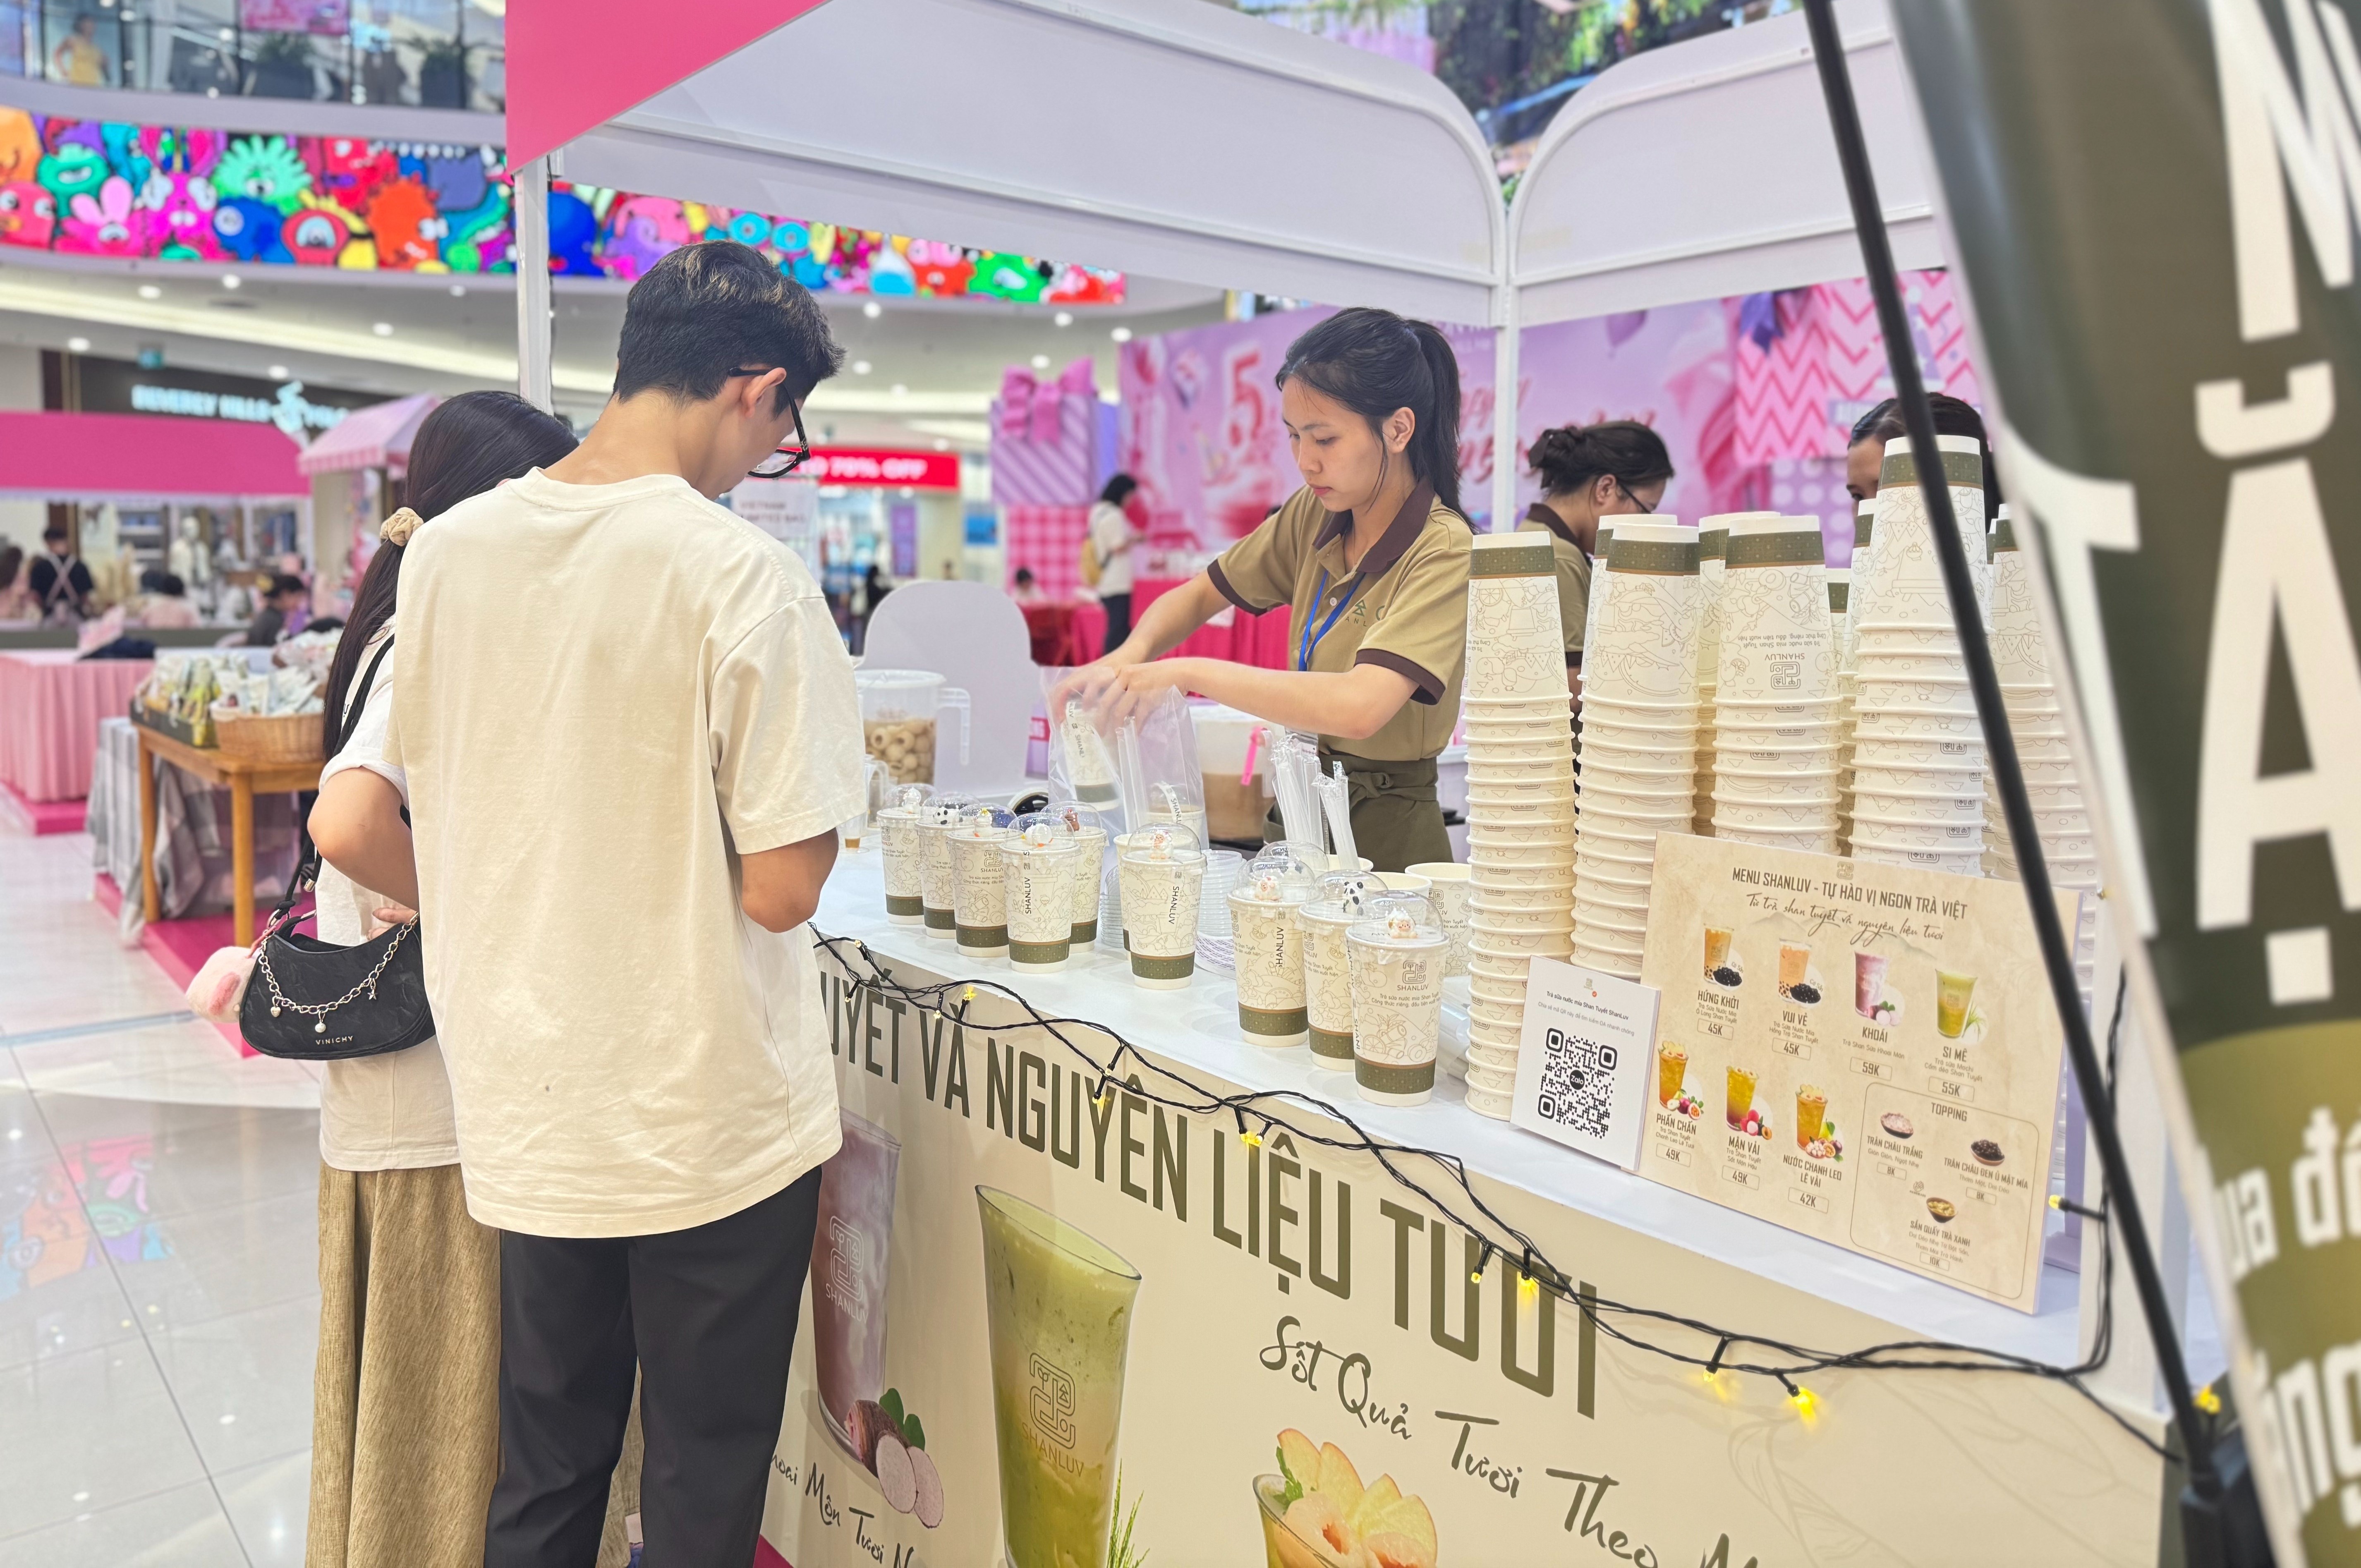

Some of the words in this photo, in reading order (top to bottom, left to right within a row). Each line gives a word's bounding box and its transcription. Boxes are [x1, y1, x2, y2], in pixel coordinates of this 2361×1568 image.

[881, 457, 928, 480] OFF
[1732, 867, 1760, 884] MENU
[1763, 872, 1811, 893] SHANLUV
[1822, 882, 1837, 900] TỰ
[1840, 883, 1863, 902] HÀO
[1866, 888, 1876, 907] VỊ
[1880, 891, 1912, 910] NGON
[1916, 896, 1937, 914] TRÀ
[1942, 900, 1968, 920] VIỆT
[1168, 886, 1179, 925] SHANLUV
[1746, 893, 1762, 907] Từ
[1763, 896, 1778, 910] trà
[1783, 898, 1805, 916] shan
[1808, 905, 1847, 937] tuyết
[1842, 913, 1853, 924] và
[1850, 919, 1898, 947] nguyên
[1899, 917, 1918, 937] liệu
[1923, 924, 1944, 940] tươi
[1698, 989, 1719, 1005] HỨNG
[1721, 995, 1739, 1010] KHỞI
[1595, 1005, 1608, 1015] Tuyết
[1609, 1010, 1629, 1020] ShanLuv
[1701, 1010, 1711, 1019] Long
[1783, 1010, 1795, 1024] VUI
[1798, 1012, 1807, 1026] VẺ
[1607, 1023, 1620, 1032] nhanh
[1708, 1022, 1723, 1036] 45K
[1862, 1026, 1888, 1043] KHOÁI
[316, 1035, 353, 1045] VINICHY
[1852, 1041, 1865, 1049] Shan
[1784, 1042, 1799, 1056] 45K
[1942, 1046, 1952, 1058] SI
[1954, 1048, 1967, 1062] MÊ
[1862, 1062, 1880, 1076] 59K
[1571, 1075, 1584, 1084] Zalo
[1942, 1082, 1961, 1097] 55K
[1931, 1102, 1967, 1122] TOPPING
[1729, 1135, 1745, 1151] MẬN
[1748, 1140, 1760, 1155] VẢI
[1867, 1135, 1882, 1147] TRÂN
[1884, 1140, 1901, 1153] CHÂU
[1903, 1145, 1923, 1159] TRẮNG
[1666, 1148, 1680, 1162] 49K
[1783, 1154, 1803, 1168] NƯỚC
[1804, 1161, 1827, 1177] CHANH
[1829, 1168, 1841, 1181] LEO
[1944, 1157, 1960, 1170] TRÂN
[1961, 1162, 1979, 1175] CHÂU
[1980, 1168, 1993, 1179] ĐEN
[2001, 1174, 2015, 1186] MẬT
[2016, 1178, 2028, 1190] MÍA
[1732, 1170, 1748, 1185] 49K
[1800, 1172, 1808, 1183] LÊ
[1810, 1176, 1821, 1188] VẢI
[1800, 1192, 1817, 1208] 42K
[919, 1002, 970, 1119] VÀ
[987, 1037, 1188, 1223] NGUYÊN
[1213, 1129, 1351, 1300] LIỆU
[1380, 1198, 1597, 1420] TƯƠI
[1910, 1220, 1923, 1231] SẮN
[1924, 1225, 1940, 1237] QUẤY
[1942, 1230, 1952, 1241] TRÀ
[1954, 1235, 1971, 1247] XANH
[1930, 1256, 1940, 1266] 10K
[825, 1283, 869, 1324] SHANLUV
[1022, 1421, 1084, 1478] SHANLUV
[1259, 1316, 1346, 1391] Sốt
[1337, 1352, 1412, 1440] Quả
[1435, 1410, 1522, 1499] Tươi
[1546, 1468, 1658, 1568] Theo
[805, 1462, 841, 1527] Môn
[848, 1506, 884, 1564] Tươi
